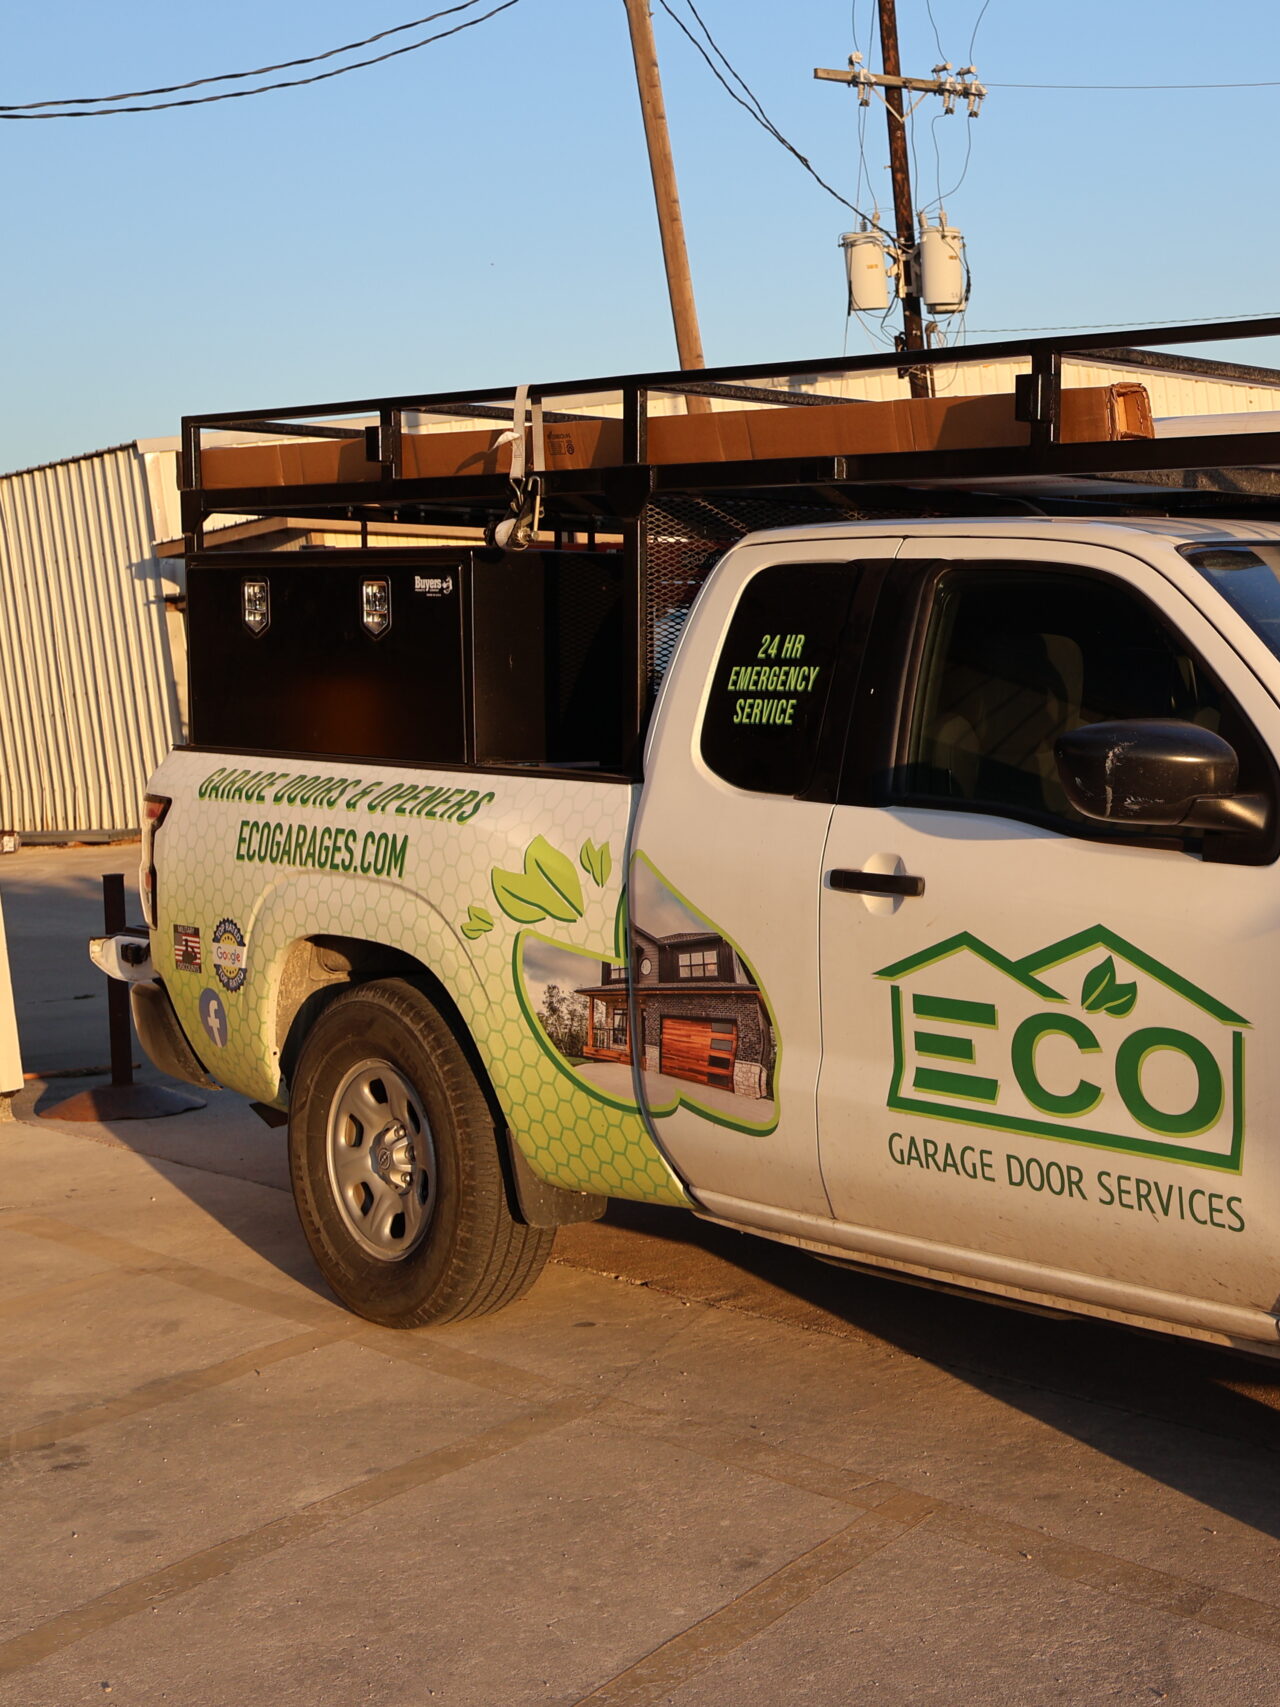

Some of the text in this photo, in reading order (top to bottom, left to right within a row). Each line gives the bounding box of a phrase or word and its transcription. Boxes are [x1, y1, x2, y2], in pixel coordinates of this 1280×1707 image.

[414, 575, 442, 592] Buyers
[757, 634, 805, 659] 24 HR
[727, 666, 820, 692] EMERGENCY
[733, 699, 797, 725] SERVICE
[199, 767, 495, 825] GARAGE DOORS & OPENERS
[235, 819, 410, 879] ECOGARAGES.COM
[177, 925, 195, 934] MILITARY
[216, 921, 242, 942] TOP RATED
[216, 945, 241, 965] Google
[177, 962, 201, 974] DISCOUNTS
[218, 968, 244, 986] TOP RATED
[912, 993, 1225, 1138] ECO
[888, 1132, 1246, 1233] GARAGE DOOR SERVICES
